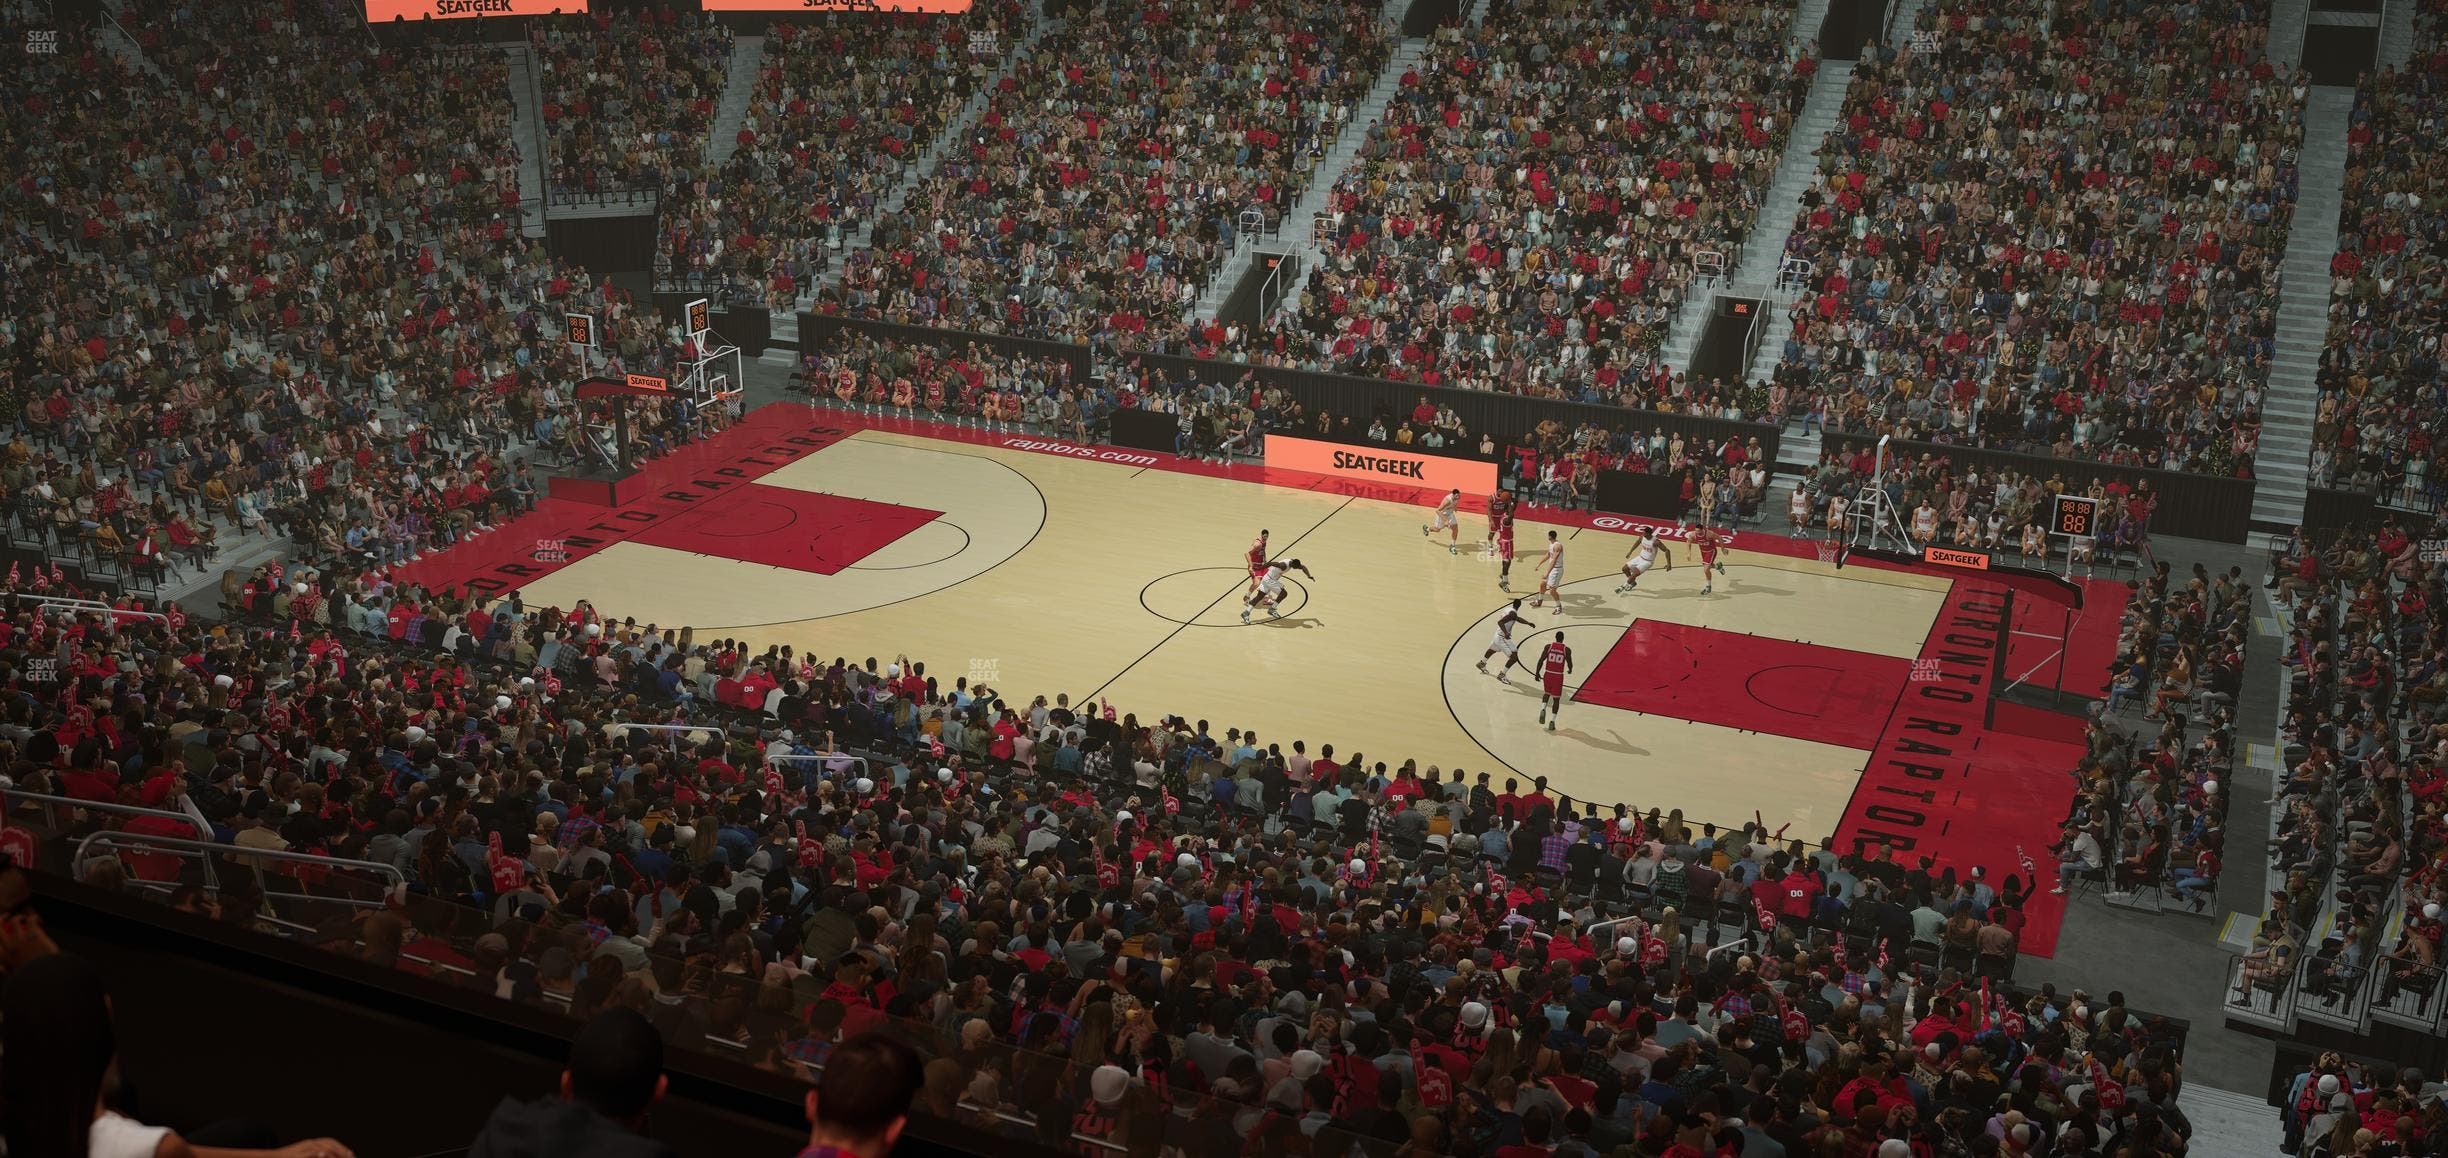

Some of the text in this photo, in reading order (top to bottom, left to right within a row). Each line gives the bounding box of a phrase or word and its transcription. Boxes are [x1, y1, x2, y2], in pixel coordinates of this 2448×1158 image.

[436, 0, 513, 15] SEATGEEK
[630, 376, 663, 388] SEATGEEK
[1003, 438, 1158, 465] raptors.com
[1333, 450, 1424, 480] SEATGEEK
[464, 425, 844, 591] ORONTO RAPTORS
[2063, 514, 2086, 533] 88
[1932, 550, 1981, 566] SEATGEEK
[1549, 652, 1565, 663] 00
[1853, 716, 1962, 852] RAPTOR
[1790, 889, 1804, 897] 00
